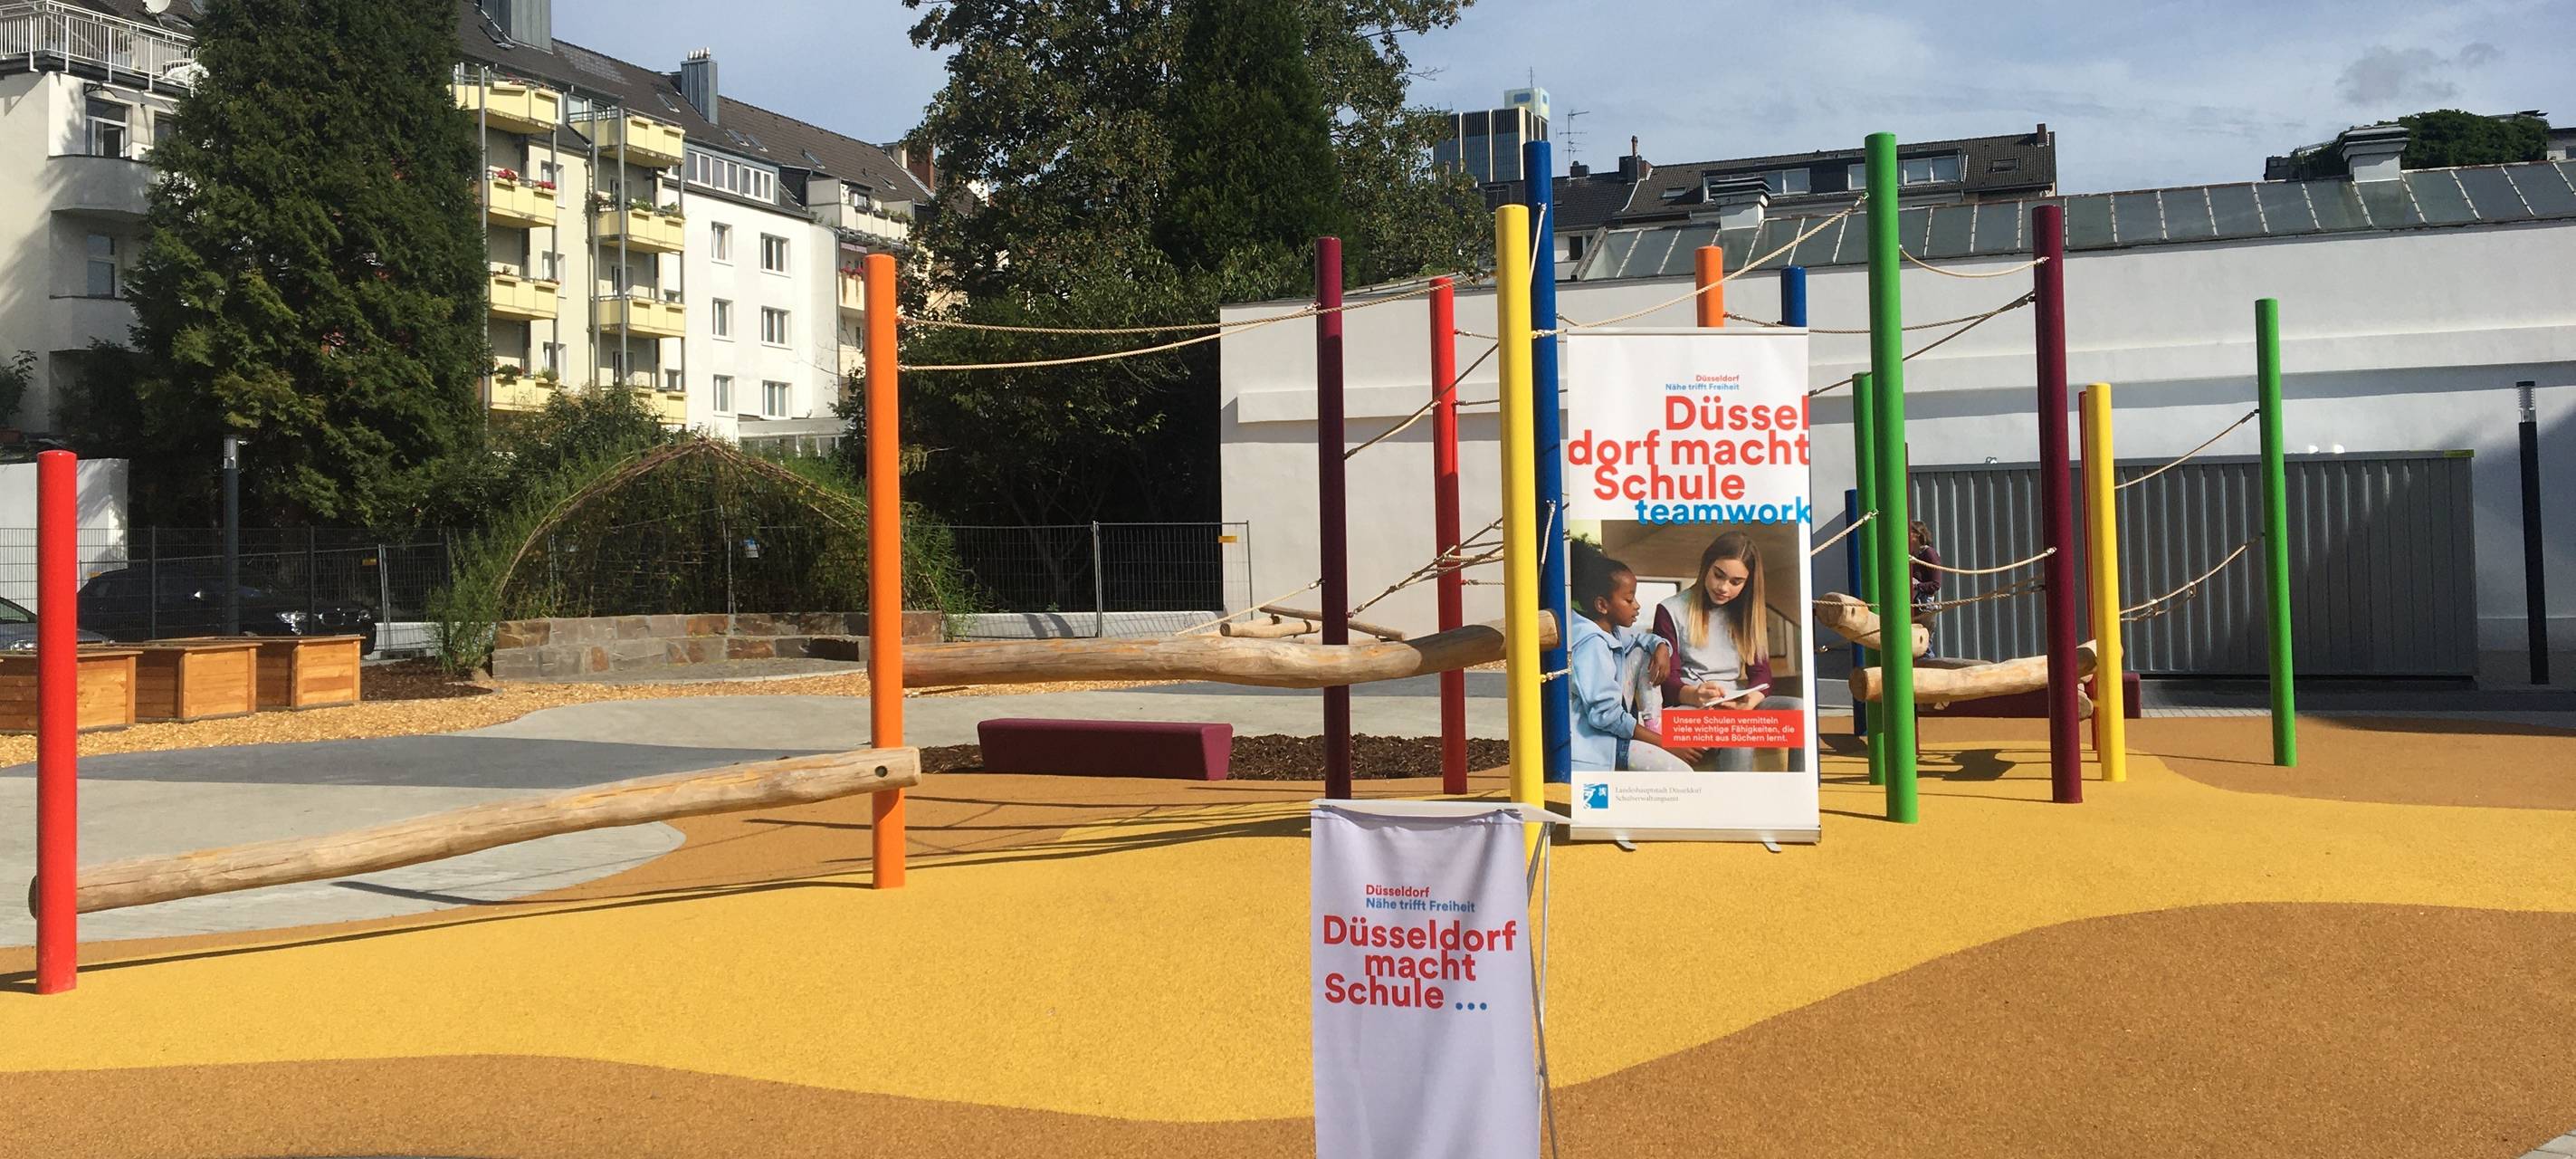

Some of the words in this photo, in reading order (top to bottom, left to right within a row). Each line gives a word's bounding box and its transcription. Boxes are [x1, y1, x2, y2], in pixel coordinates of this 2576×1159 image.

[1695, 374, 1740, 382] Düsseldorf
[1665, 395, 1809, 430] Düssel
[1568, 429, 1660, 465] dorf
[1671, 429, 1809, 465] macht
[1594, 464, 1745, 501] Schule
[1635, 496, 1810, 525] teamwork
[1673, 716, 1702, 724] Unsere
[1703, 716, 1736, 724] Schulen
[1737, 716, 1779, 724] vermitteln
[1694, 725, 1729, 734] wichtige
[1731, 733, 1764, 742] Büchern
[1615, 786, 1668, 795] Landeshauptstadt
[1366, 884, 1430, 897] Düsseldorf
[1366, 897, 1398, 910] Nähe
[1399, 899, 1426, 911] trifft
[1429, 900, 1475, 913] Freiheit
[1323, 915, 1517, 952] Düsseldorf
[1365, 950, 1476, 982] macht
[1324, 972, 1445, 1010] Schule
